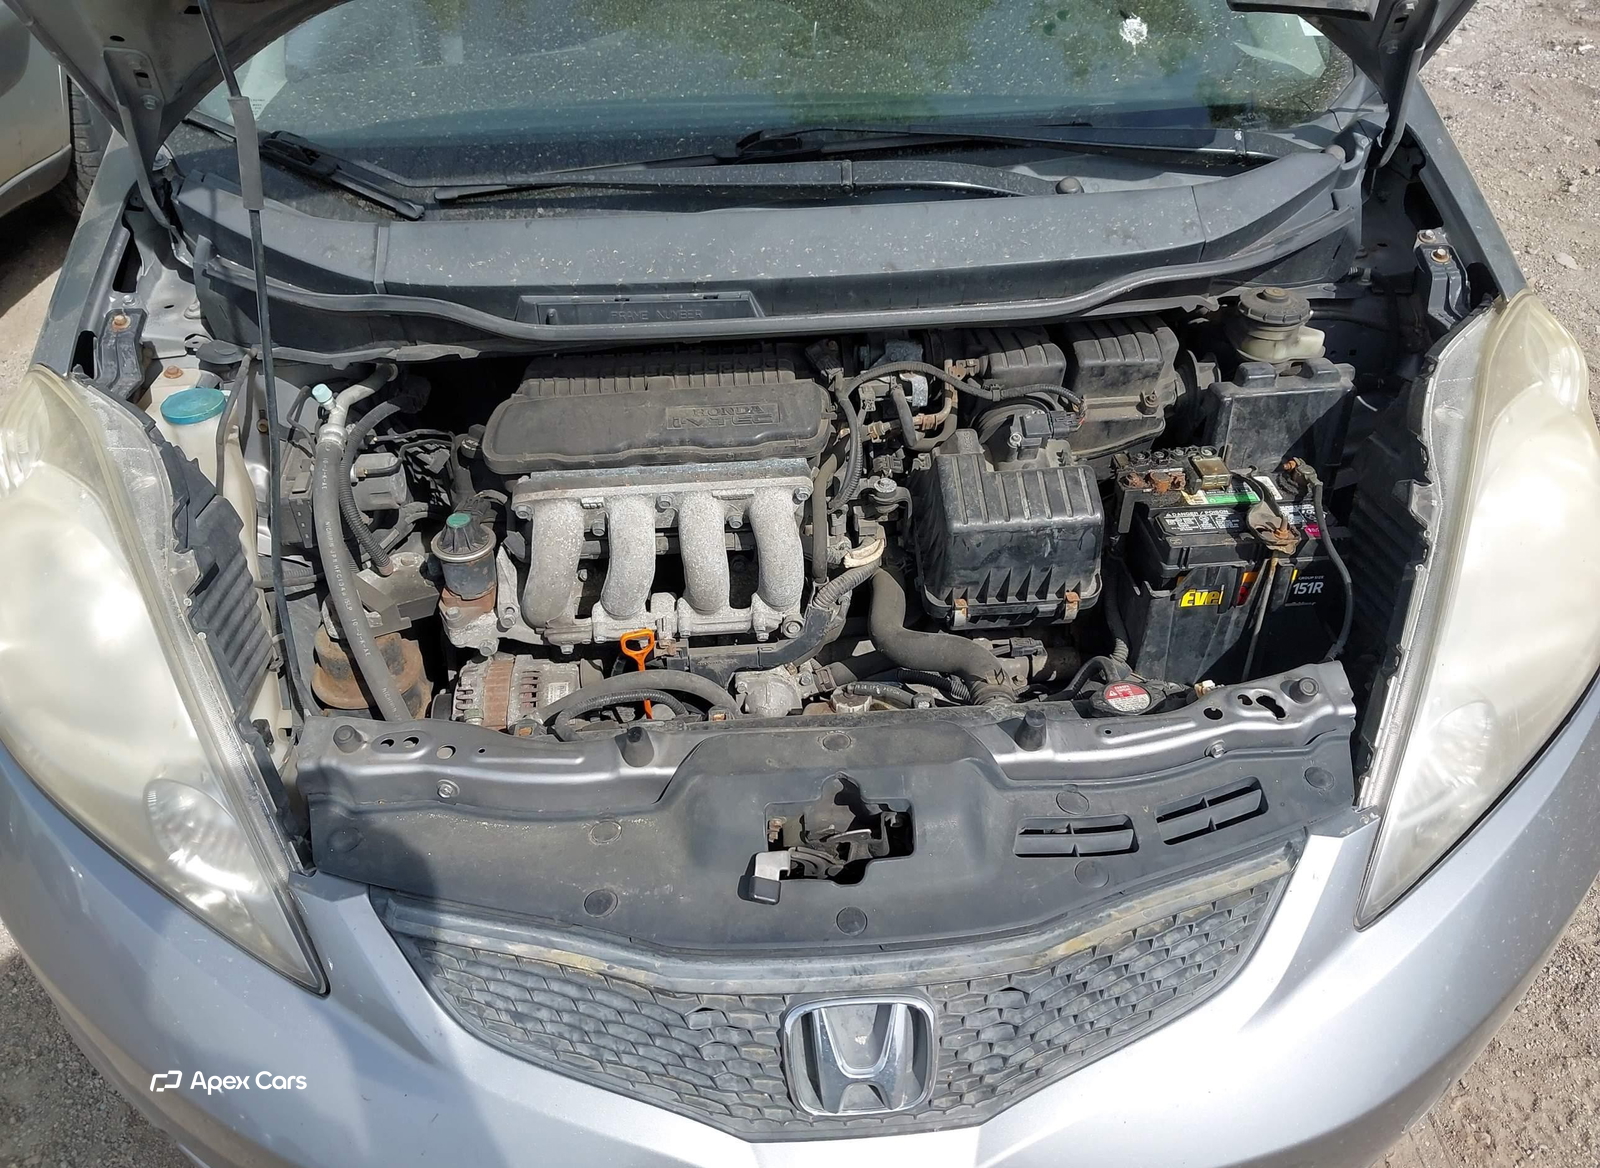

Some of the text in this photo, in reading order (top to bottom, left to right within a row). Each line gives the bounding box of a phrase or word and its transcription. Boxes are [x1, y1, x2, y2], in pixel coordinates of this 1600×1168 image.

[610, 309, 703, 320] FRAME NUMBER
[692, 405, 765, 417] HONDA
[1292, 582, 1324, 595] 151R
